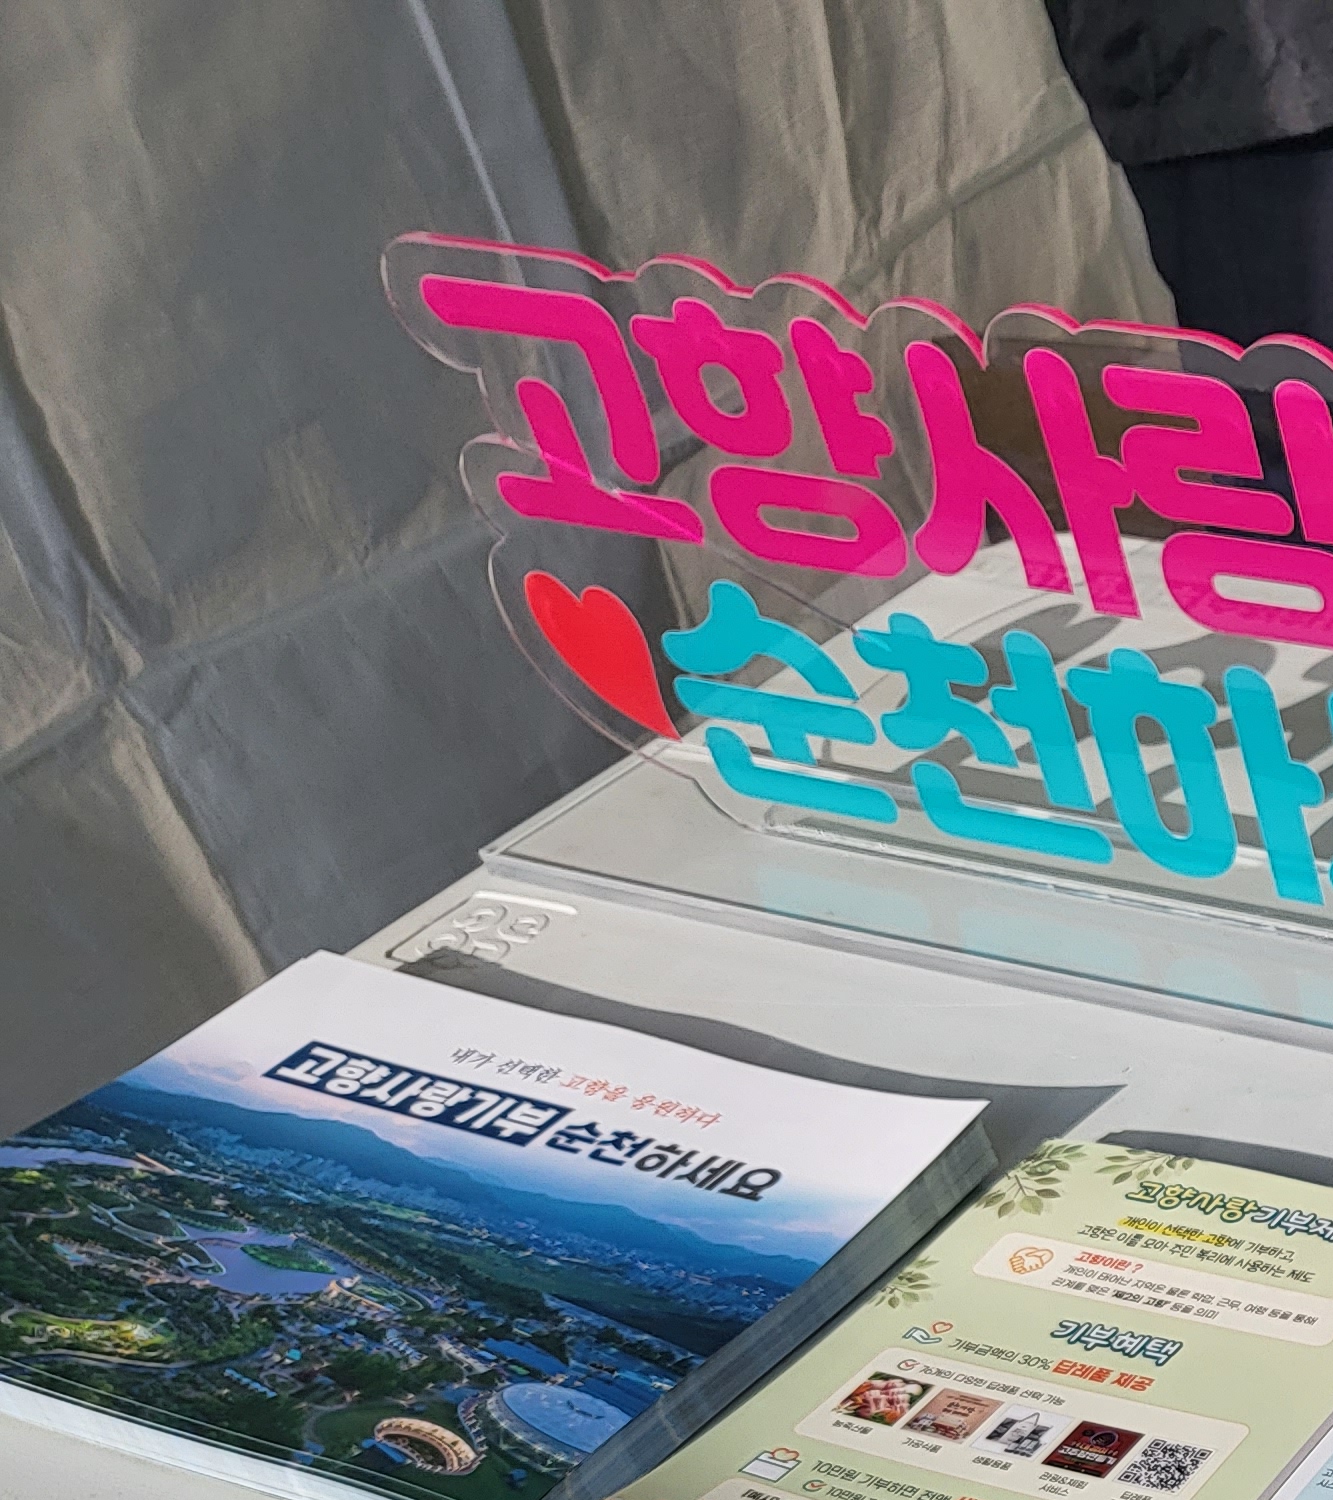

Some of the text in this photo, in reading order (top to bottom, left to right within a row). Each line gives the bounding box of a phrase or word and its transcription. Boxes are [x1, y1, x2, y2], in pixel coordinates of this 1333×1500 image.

[451, 1047, 723, 1129] 내가 선택한 고향을 응원하다
[277, 1046, 783, 1200] 고향사랑기부 순천하세요
[1077, 1224, 1316, 1283] 고향은 이를 모아 주민 복리에 사용하는 제도
[1123, 1215, 1161, 1234] 개인이
[1163, 1223, 1203, 1241] 선택한
[1203, 1231, 1245, 1249] 고향에
[949, 1337, 1157, 1393] 기부금액의 30% 답례품 제공
[1049, 1319, 1185, 1367] 기부혜택
[811, 1460, 859, 1486] 10만원
[863, 1471, 920, 1500] 기부하면
